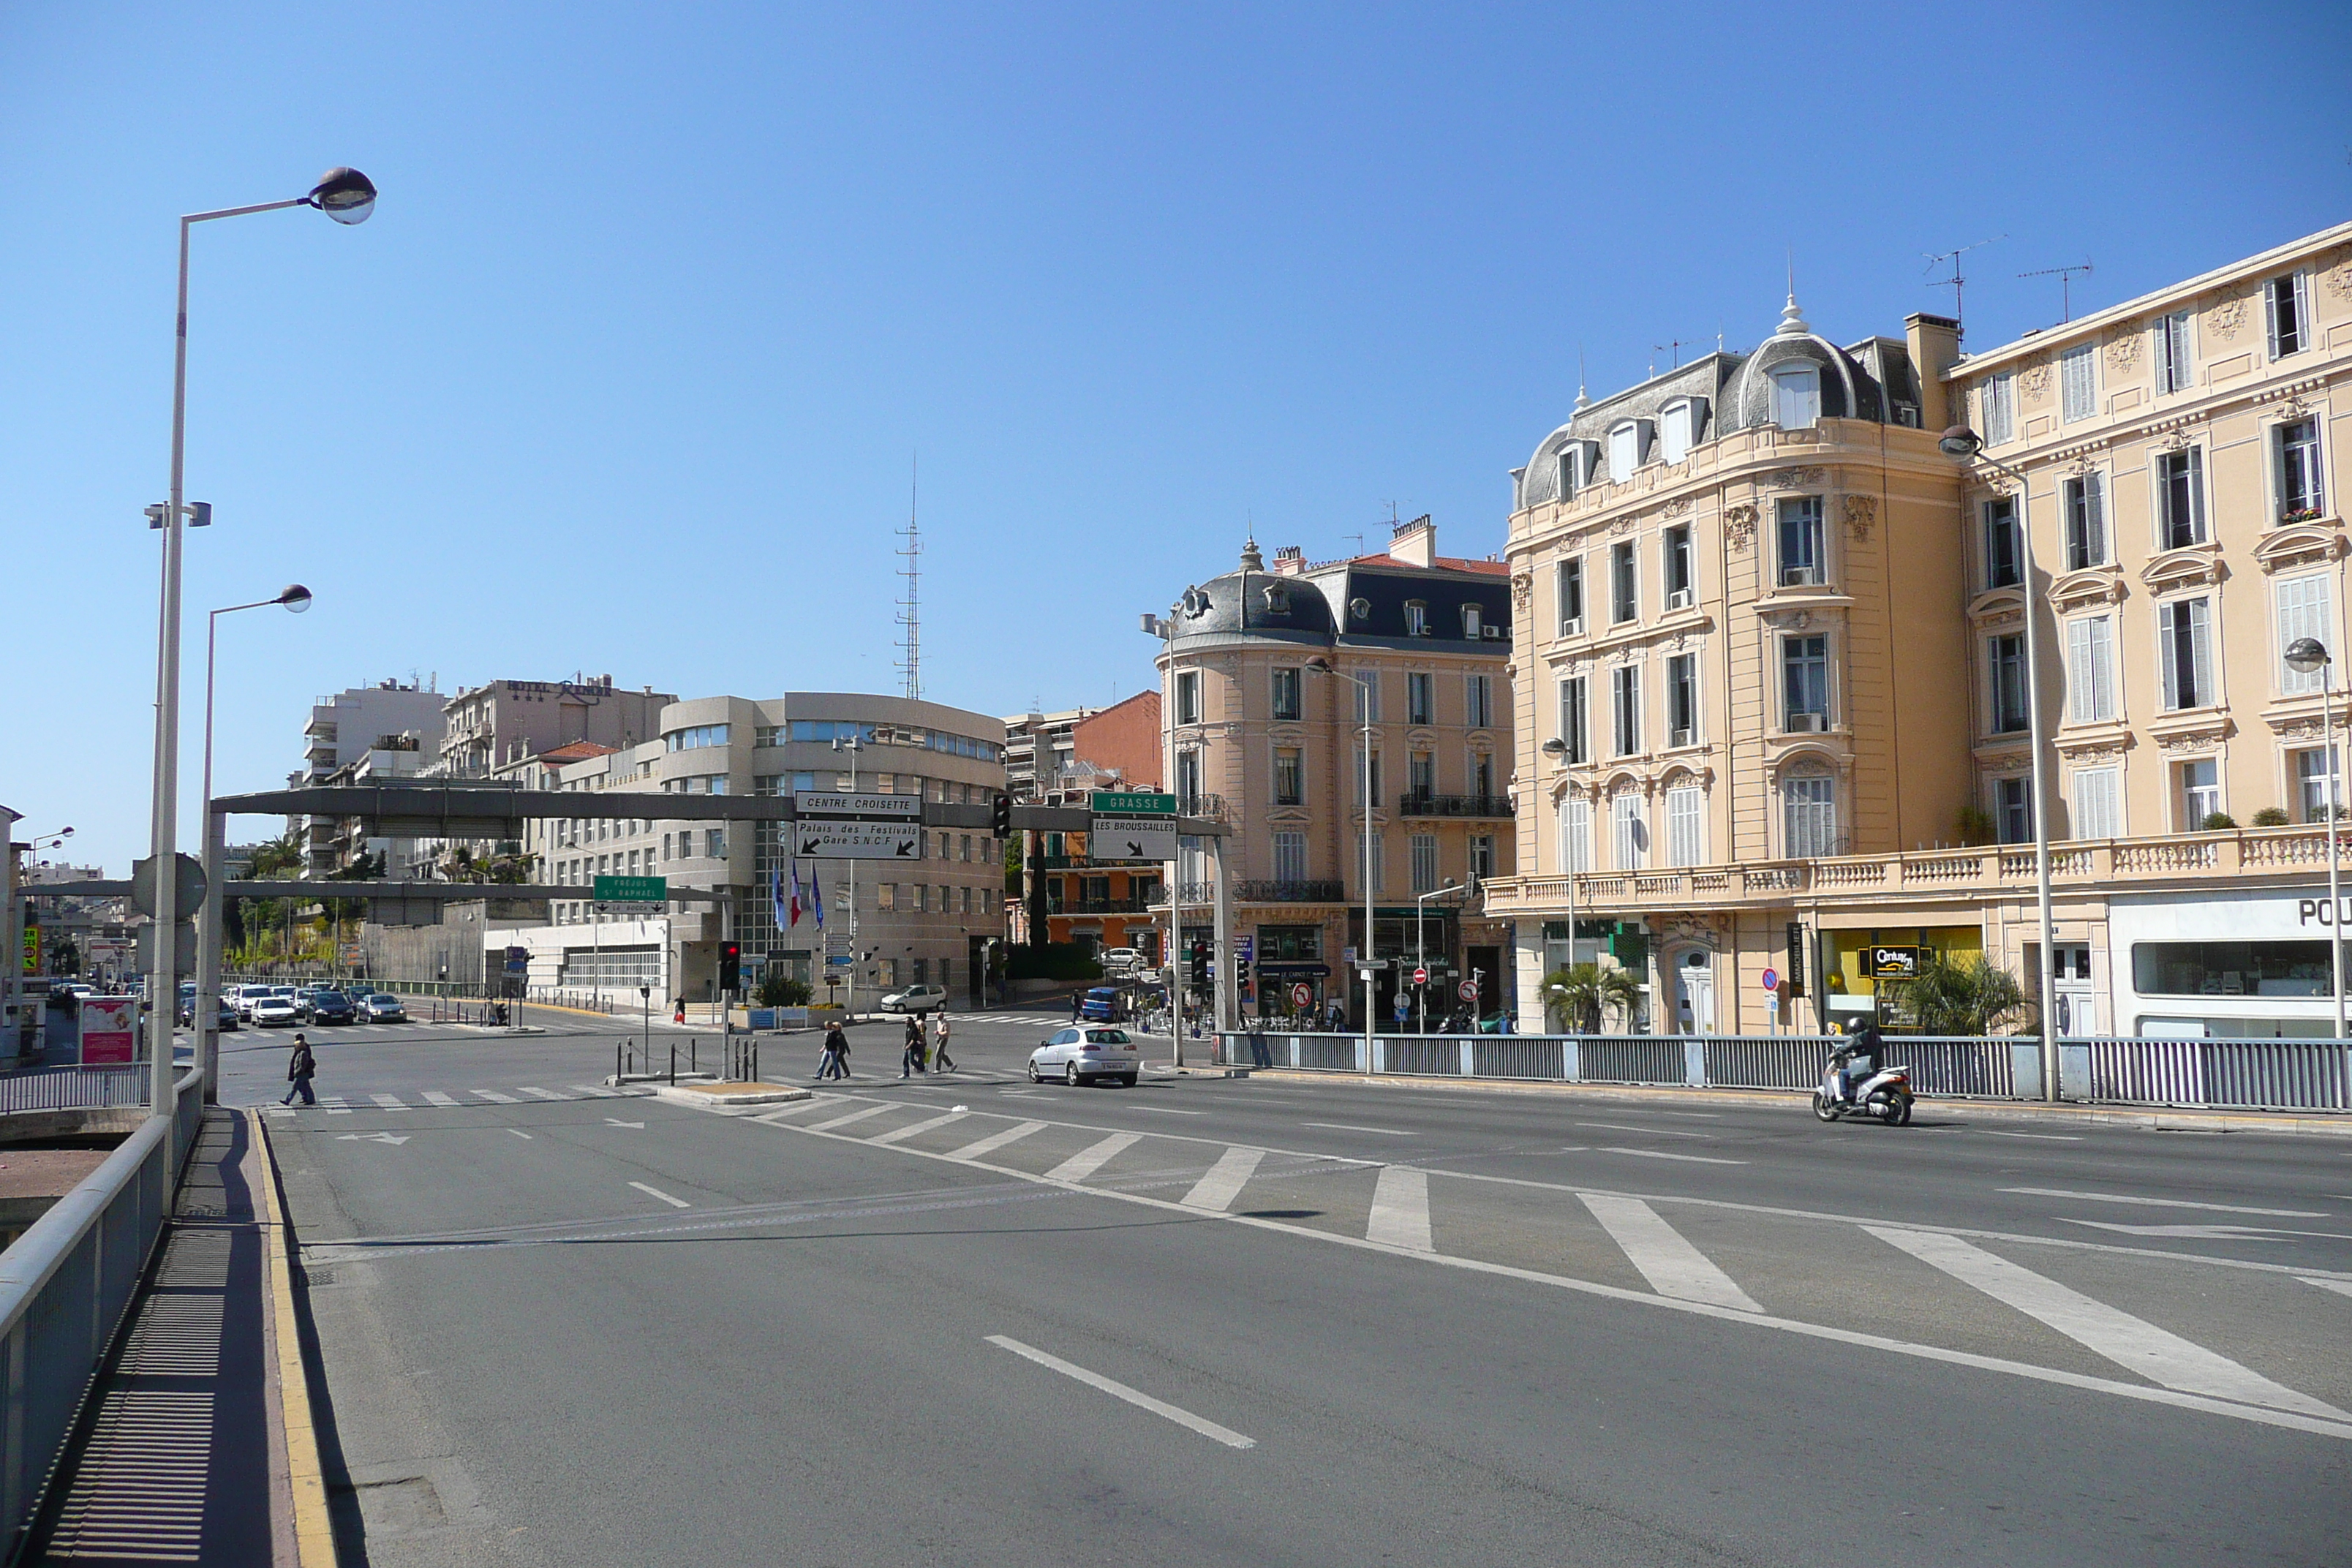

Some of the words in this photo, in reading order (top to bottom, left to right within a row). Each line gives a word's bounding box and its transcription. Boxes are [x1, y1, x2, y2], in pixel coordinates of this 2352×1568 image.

[807, 798, 848, 807] CENTRE
[854, 799, 910, 810] CROISETTE
[1110, 797, 1159, 808] GRASSE
[799, 823, 832, 832] Palais
[841, 824, 859, 834] des
[870, 825, 917, 834] Festivals
[1096, 821, 1110, 830] LES
[1114, 822, 1175, 832] BROUSSAILLES
[823, 835, 848, 844] Gare
[1542, 916, 1618, 939] PHAMACIE
[1793, 927, 1802, 982] IMMOBILIER
[1877, 949, 1907, 963] Century
[1903, 957, 1913, 970] 21
